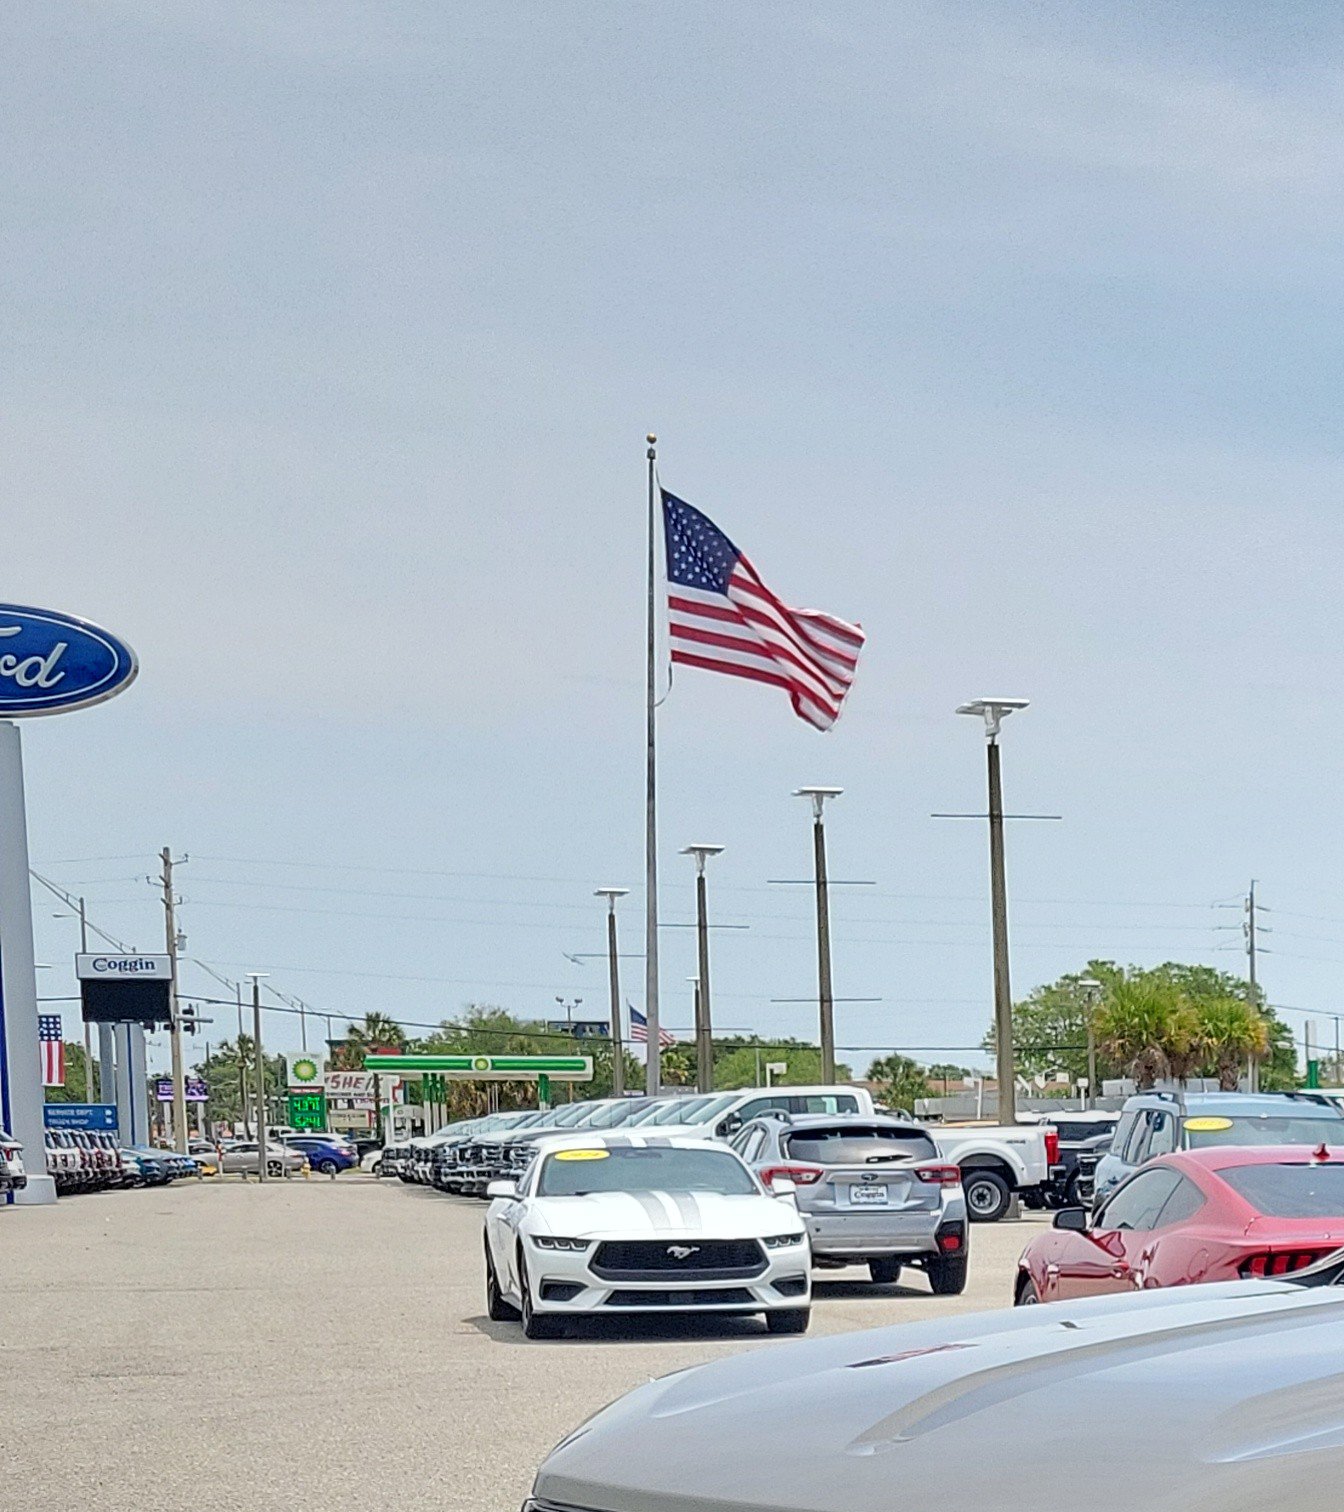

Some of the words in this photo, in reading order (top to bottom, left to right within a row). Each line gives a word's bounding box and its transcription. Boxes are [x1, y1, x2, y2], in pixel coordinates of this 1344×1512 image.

[0, 625, 68, 688] rd
[92, 957, 156, 973] Coggin
[330, 1074, 384, 1092] SHEI
